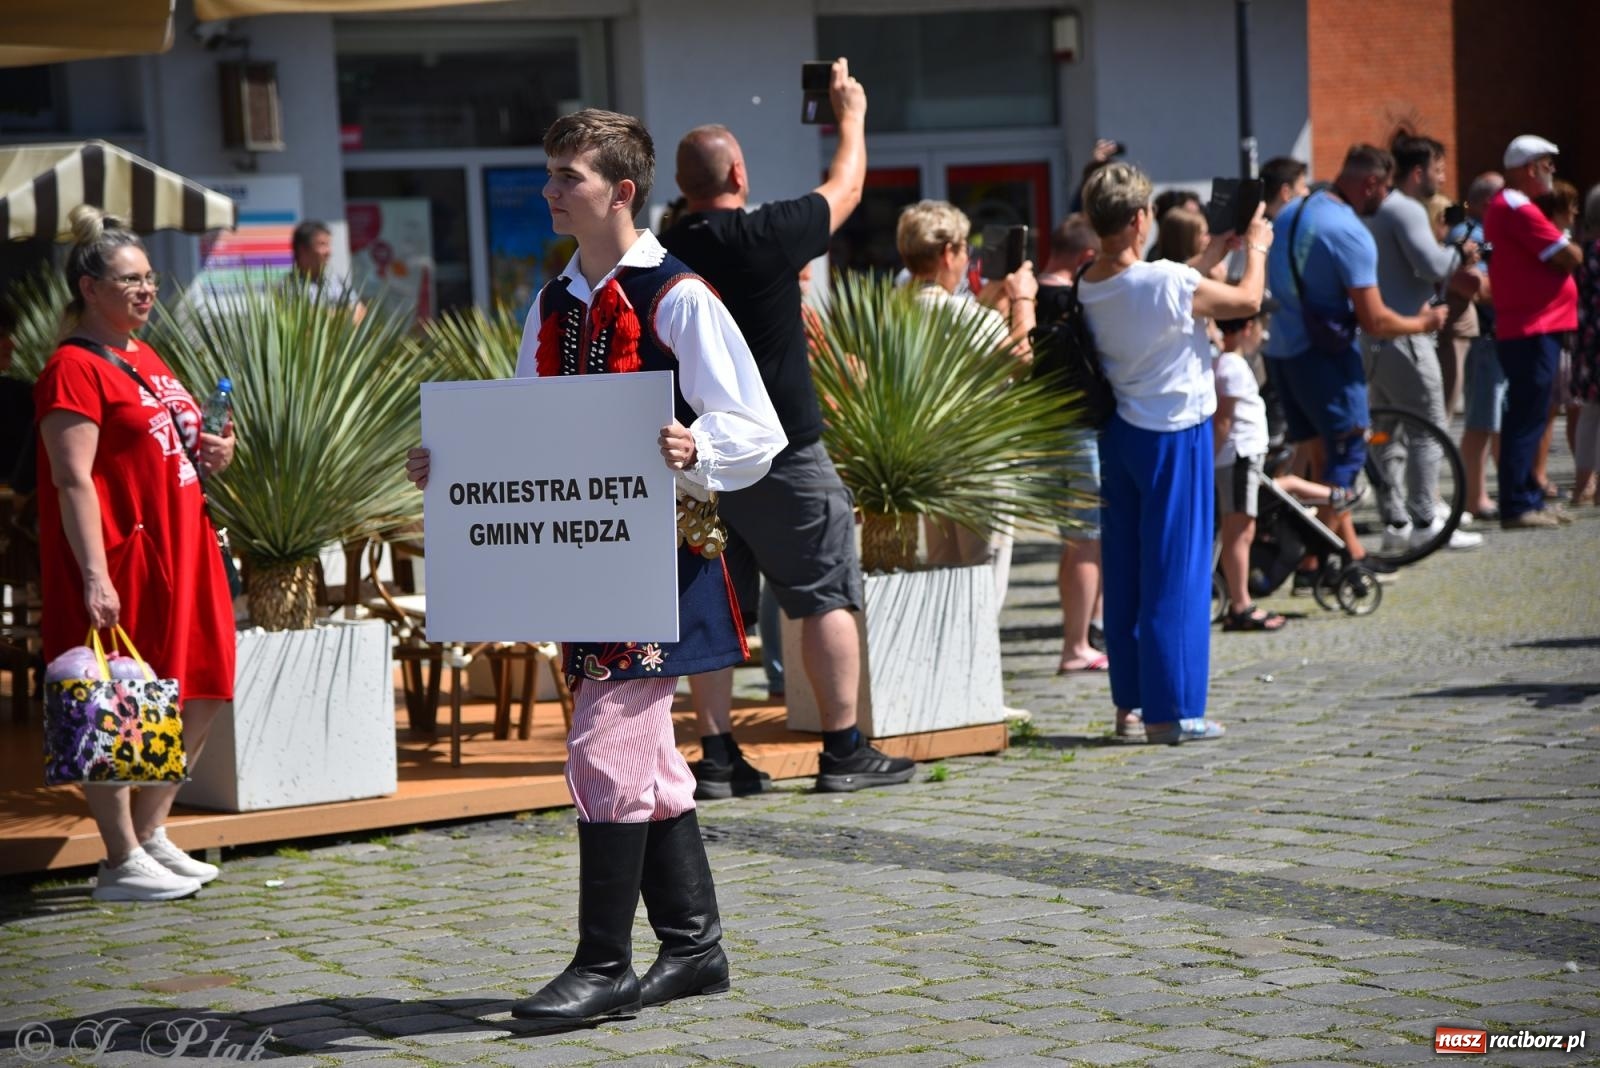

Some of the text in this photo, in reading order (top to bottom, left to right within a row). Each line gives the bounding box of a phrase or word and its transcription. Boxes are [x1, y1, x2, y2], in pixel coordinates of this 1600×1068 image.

[449, 476, 648, 505] ORKIESTRA DĘTA
[469, 519, 630, 549] GMINY NĘDZA
